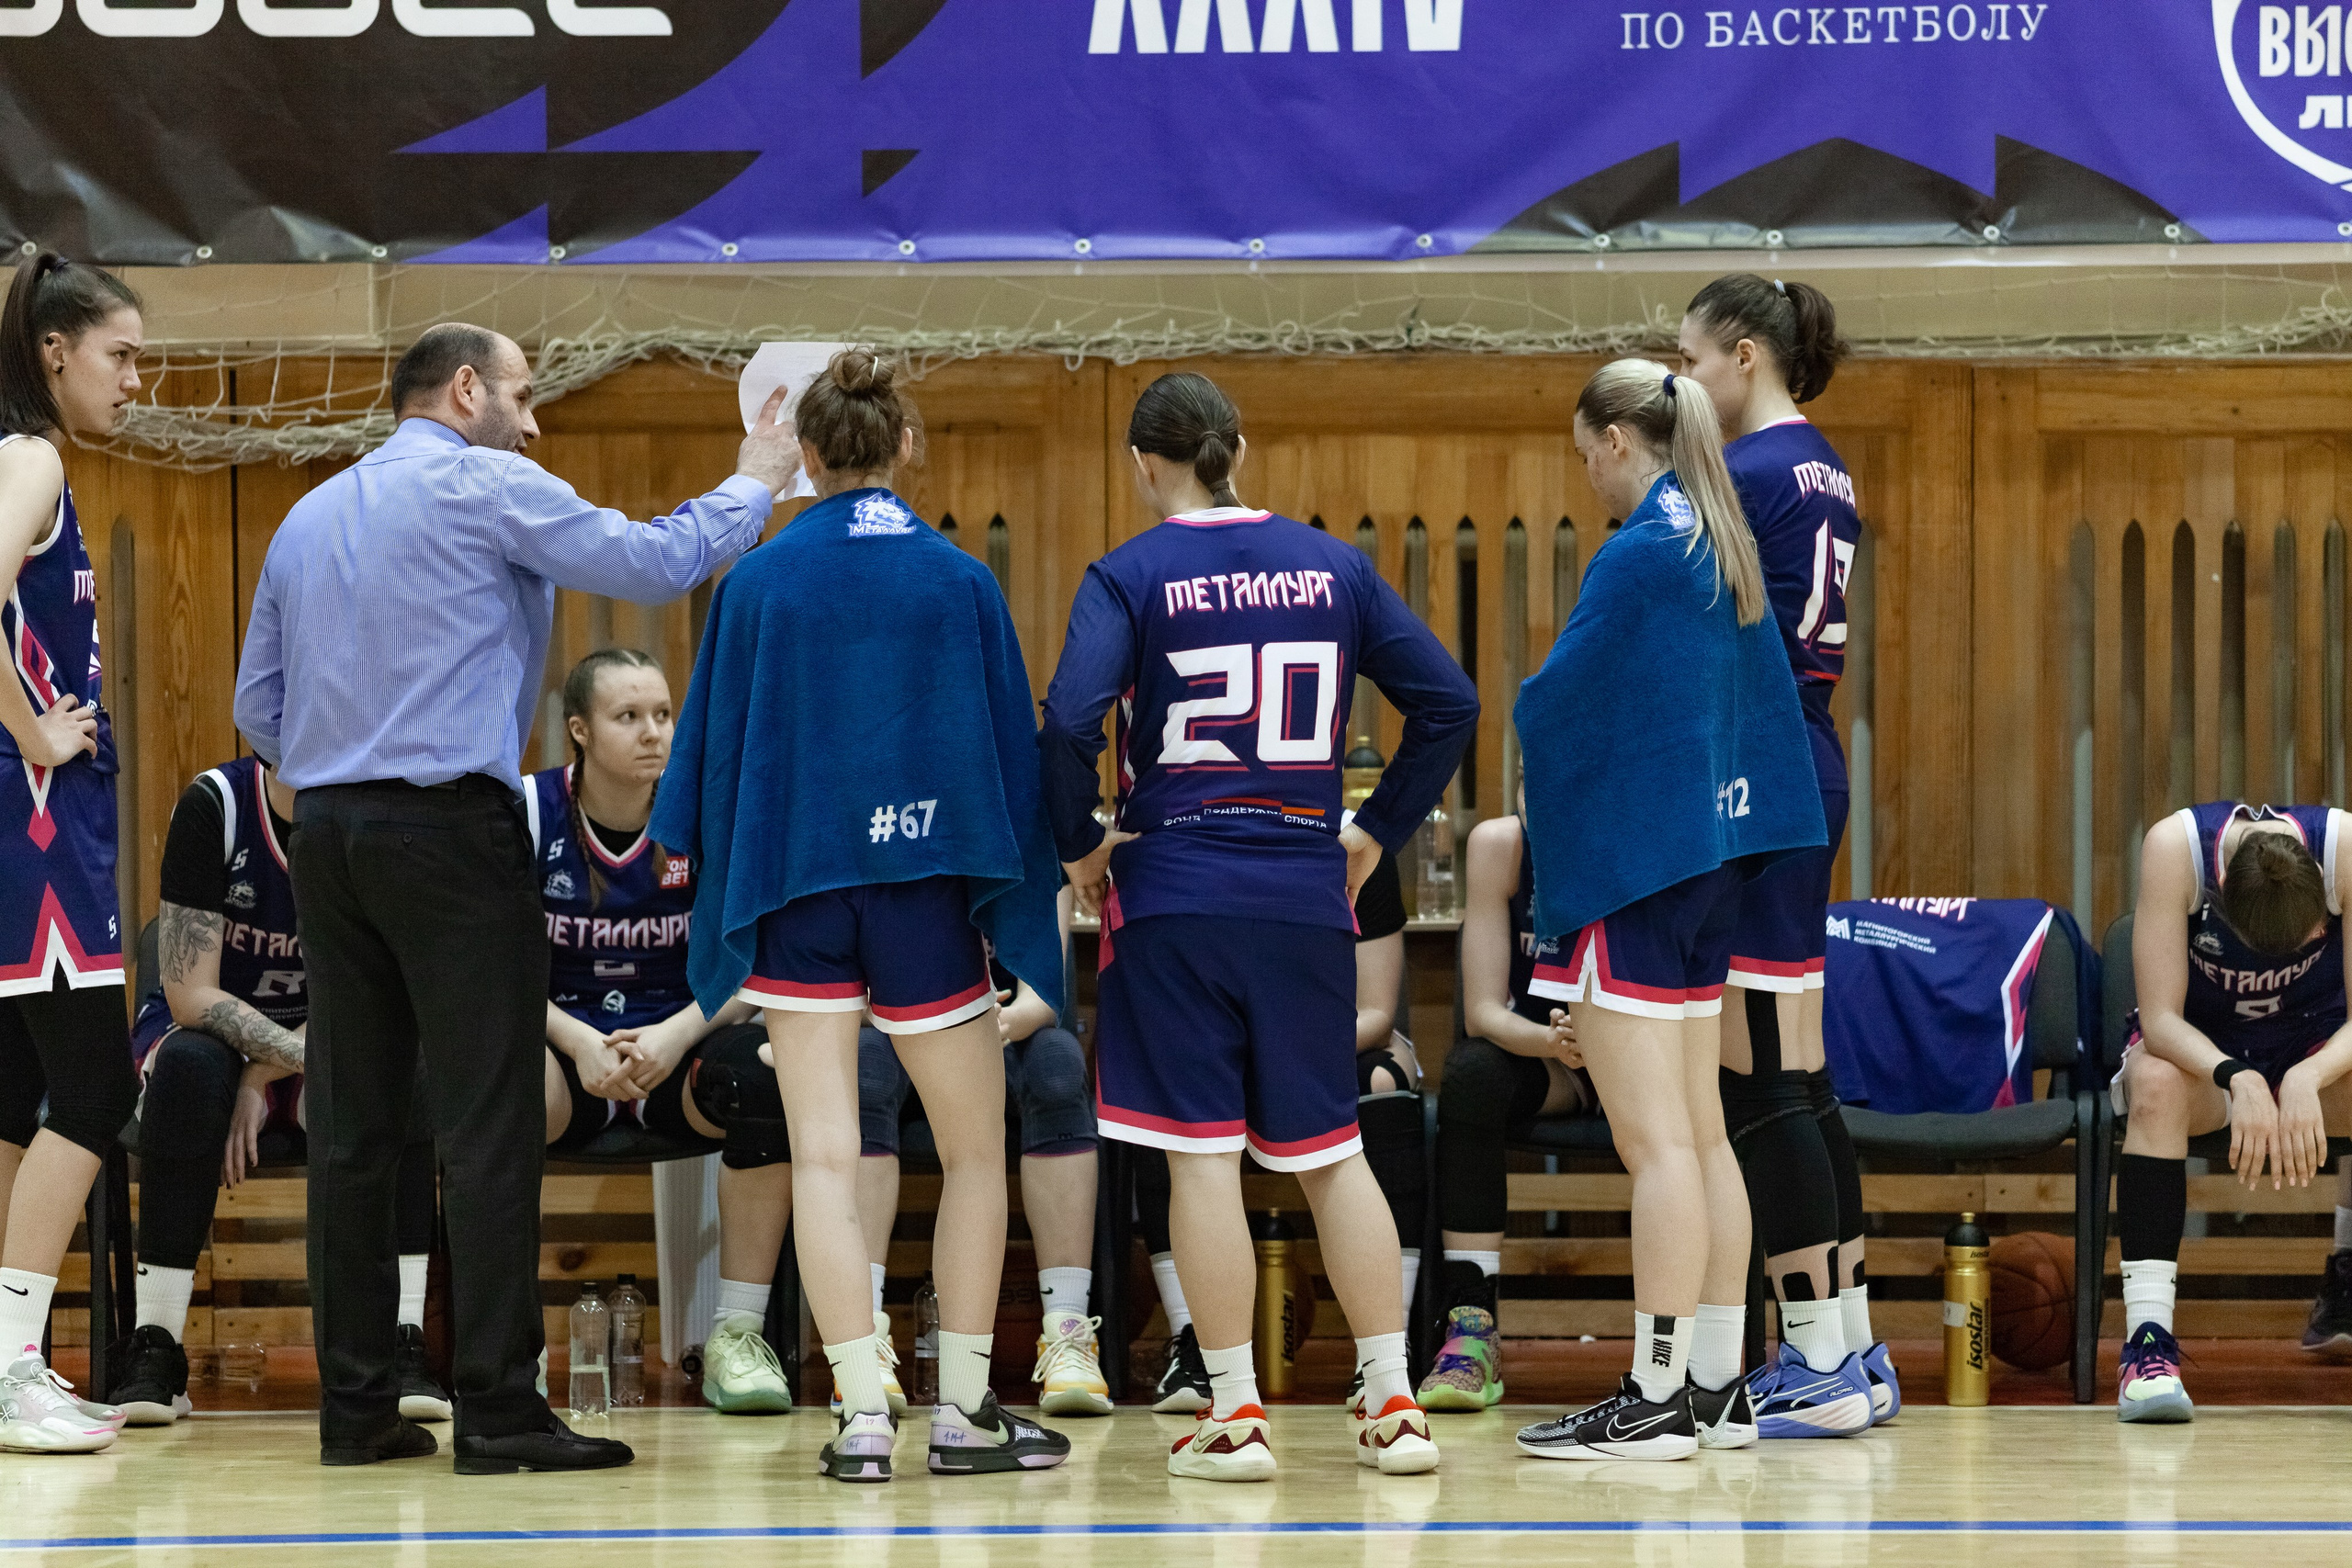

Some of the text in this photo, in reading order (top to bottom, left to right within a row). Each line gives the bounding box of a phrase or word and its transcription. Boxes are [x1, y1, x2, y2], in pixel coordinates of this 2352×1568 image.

[1620, 4, 2050, 50] ПО БАСКЕТБОЛУ
[2258, 5, 2352, 77] ВЫ
[1164, 570, 1335, 618] МЕТАЛЛУРГ
[1157, 641, 1343, 772] 20
[868, 799, 938, 843] #67
[1716, 777, 1750, 821] #12
[1652, 1337, 1673, 1368] NIKE
[1966, 1301, 1983, 1371] isostar
